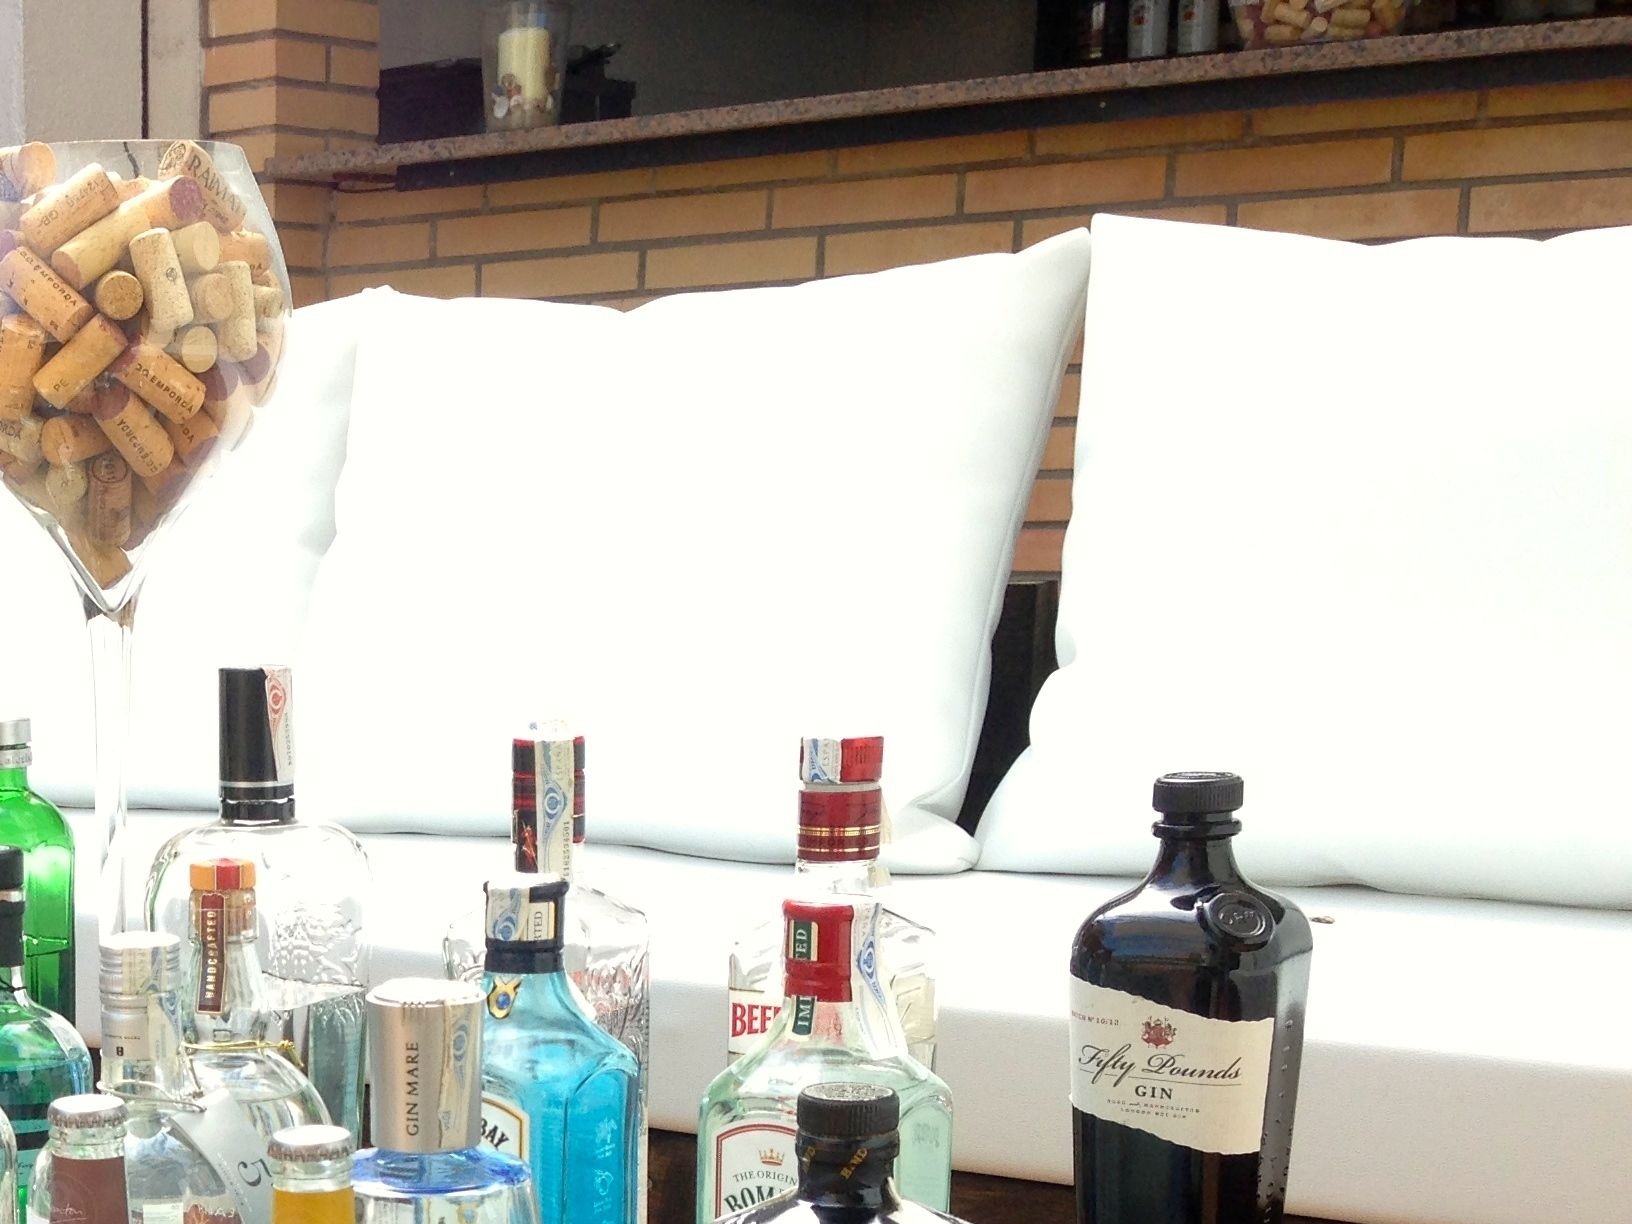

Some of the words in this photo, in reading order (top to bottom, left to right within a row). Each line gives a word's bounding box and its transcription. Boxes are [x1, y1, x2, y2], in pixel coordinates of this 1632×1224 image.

[405, 1041, 419, 1096] MARE
[1078, 1043, 1136, 1088] Fifty
[1141, 1053, 1243, 1081] Pounds
[1135, 1085, 1173, 1101] GIN
[406, 1102, 419, 1137] GIN
[733, 1170, 756, 1183] THE
